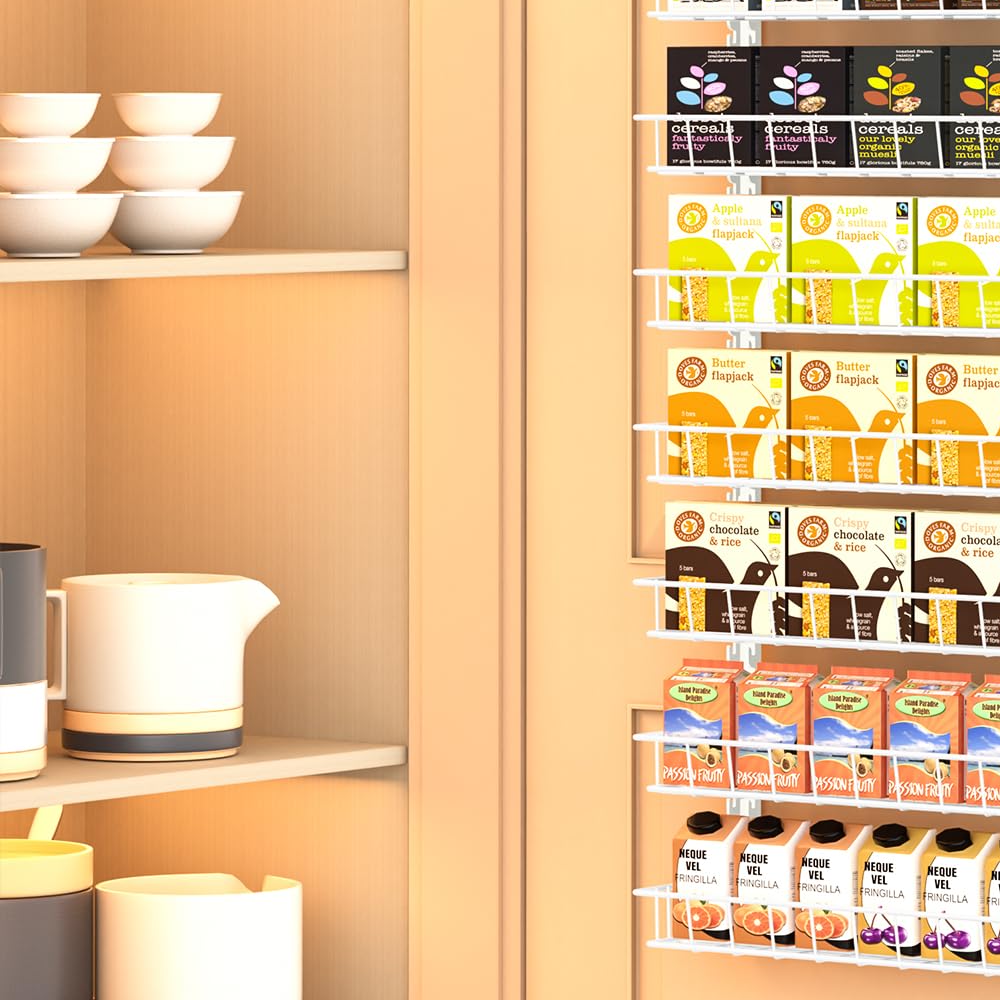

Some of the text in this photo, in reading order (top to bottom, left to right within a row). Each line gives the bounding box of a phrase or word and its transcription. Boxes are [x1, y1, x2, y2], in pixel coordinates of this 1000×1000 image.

[671, 123, 735, 134] cereals
[764, 123, 829, 134] cereals
[858, 124, 924, 134] cereals
[882, 135, 916, 144] lovely
[671, 143, 706, 151] fruty
[712, 203, 743, 215] Apple
[836, 205, 868, 217] Apple
[963, 206, 996, 219] Apple
[712, 229, 754, 241] flapjack
[836, 231, 880, 243] flapjack
[712, 357, 745, 368] Butter
[836, 361, 870, 372] Butter
[963, 364, 998, 375] Butter
[712, 371, 754, 383] flapjack
[836, 374, 879, 387] flapjack
[709, 512, 744, 525] Crispy
[833, 517, 869, 530] Crispy
[709, 525, 759, 535] chocolate
[961, 521, 997, 535] Crispy
[833, 530, 885, 541] chocolate
[709, 537, 741, 546] & rice
[833, 542, 866, 552] & rice
[961, 547, 994, 557] & rice
[663, 766, 696, 781] PASSION
[736, 770, 772, 786] PASSION
[814, 775, 847, 791] PASSION
[679, 848, 707, 860] NEQUE
[740, 853, 768, 864] NEQUE
[686, 861, 702, 872] VEL
[802, 857, 830, 869] NEQUE
[864, 861, 894, 873] NEQUE
[747, 865, 763, 876] VEL
[808, 870, 825, 881] VEL
[927, 866, 957, 878] NEQUE
[871, 874, 888, 885] VEL
[934, 879, 951, 890] VEL
